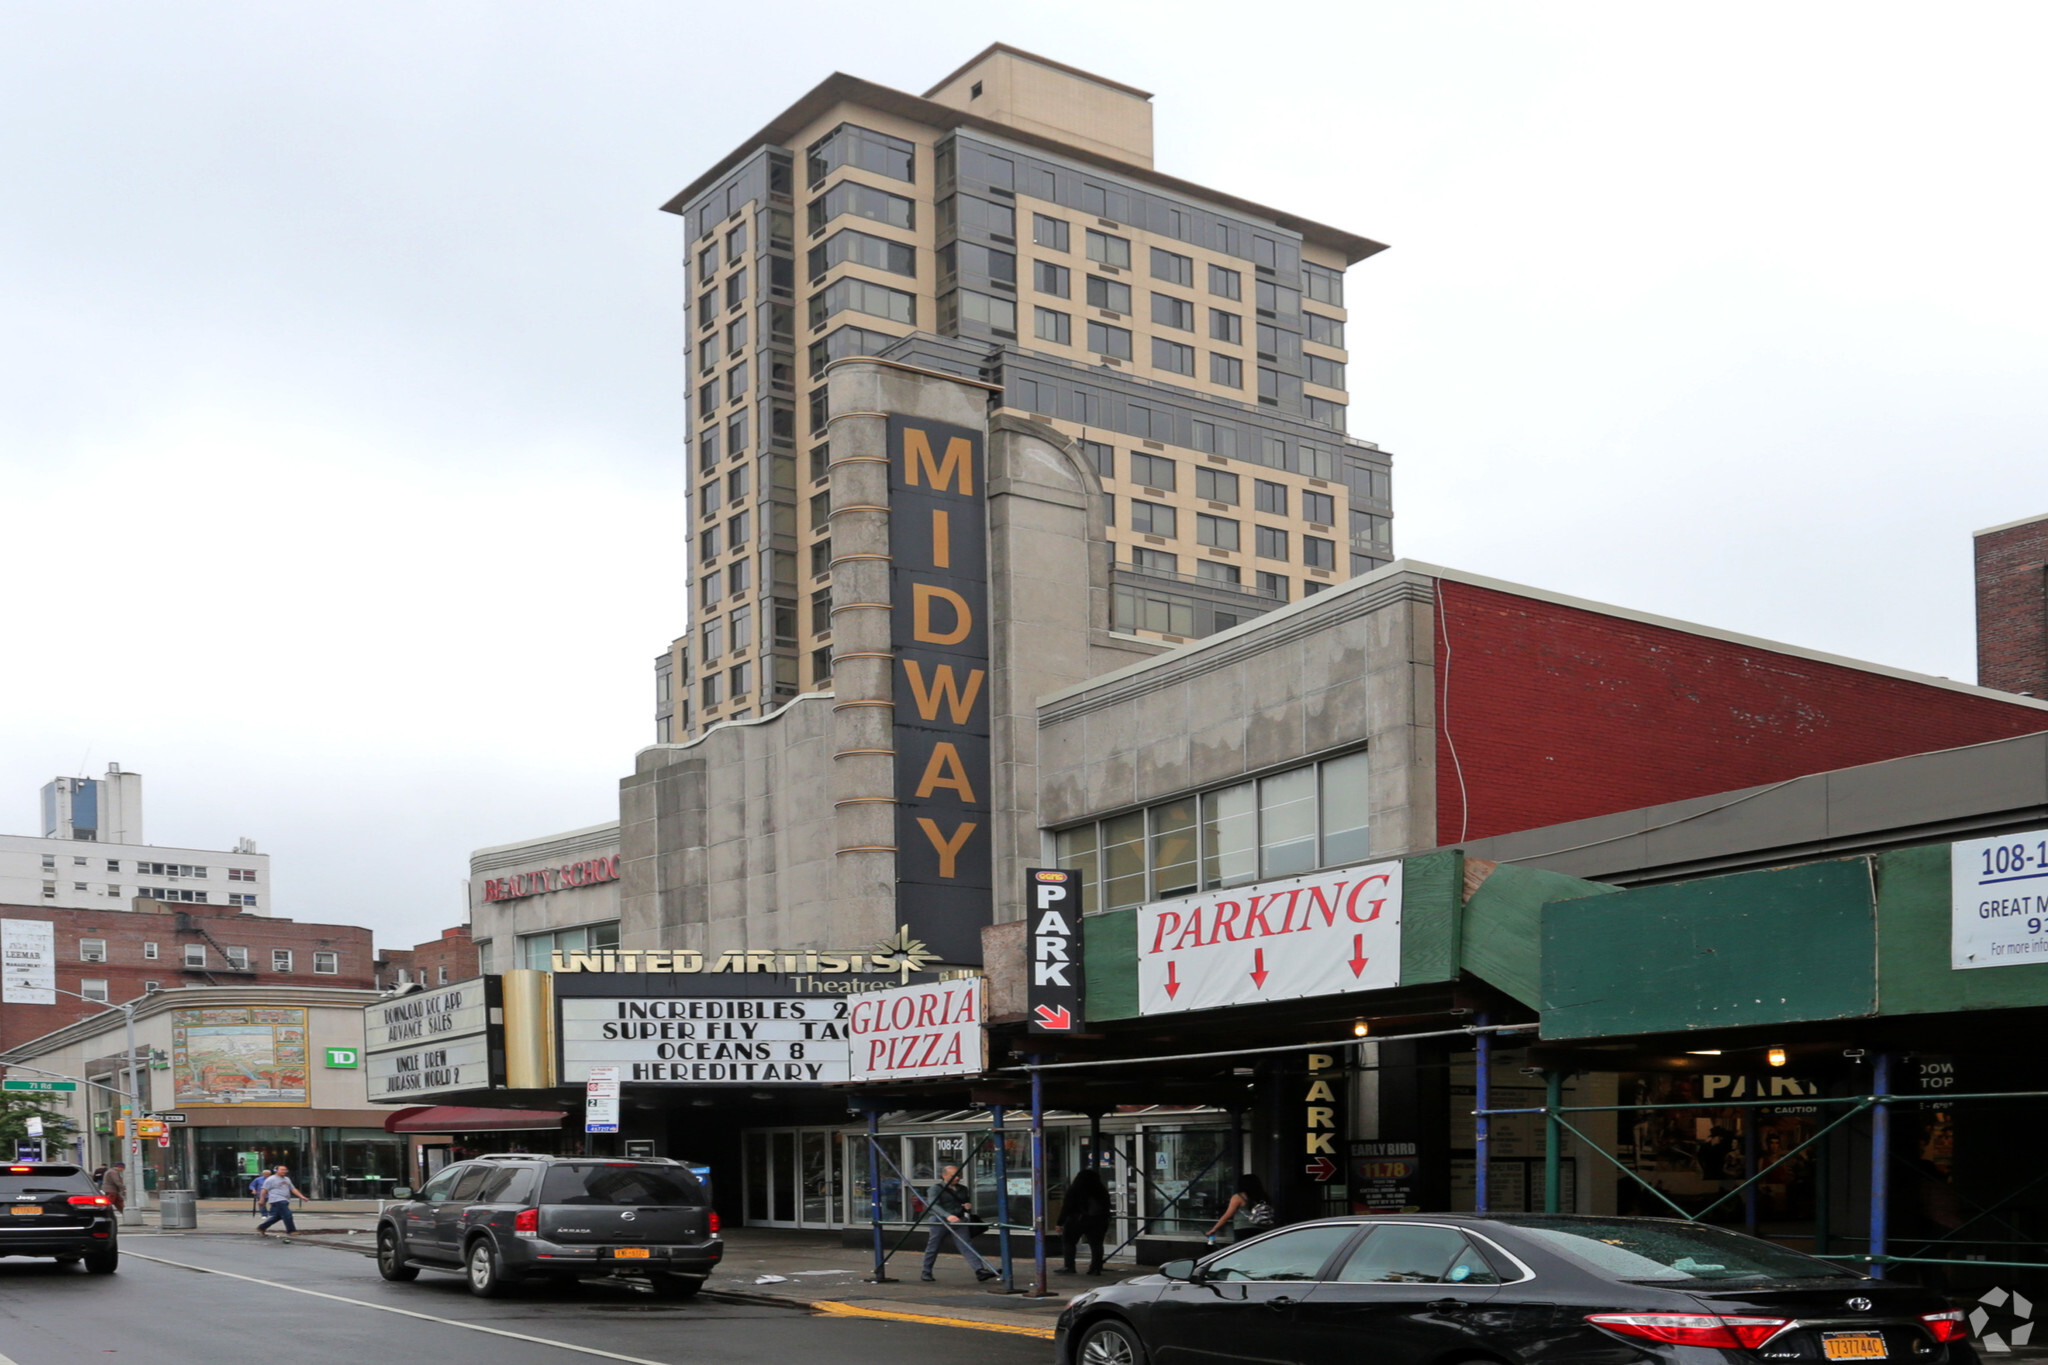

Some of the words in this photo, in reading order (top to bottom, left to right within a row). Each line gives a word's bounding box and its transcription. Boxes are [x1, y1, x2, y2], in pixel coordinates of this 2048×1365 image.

[903, 427, 985, 878] MIDWAY
[484, 869, 552, 902] BEAUTY
[1148, 874, 1390, 954] PARKING
[1979, 896, 2031, 919] GREAT
[1035, 884, 1071, 986] PARK
[5, 950, 41, 959] LEEMAR
[1991, 942, 2005, 956] For
[2007, 943, 2030, 955] more
[551, 949, 703, 973] UNITED
[711, 949, 900, 973] ARTISTS
[789, 975, 896, 994] Theatres
[384, 1001, 423, 1024] DOWNLOAD
[444, 992, 463, 1011] APP
[618, 1001, 806, 1019] INCREDIBLES
[833, 1002, 848, 1019] 2
[851, 987, 976, 1034] GLORIA
[388, 1020, 422, 1041] ADVANCE
[428, 1013, 453, 1034] SALES
[602, 1022, 695, 1040] SUPER
[707, 1022, 758, 1040] FLY
[327, 1050, 356, 1064] TD
[396, 1054, 419, 1073] UNCLE
[424, 1049, 447, 1069] DREW
[657, 1042, 771, 1060] OCEANS
[789, 1042, 804, 1060] 8
[866, 1031, 964, 1071] PIZZA
[386, 1073, 421, 1092] JURASSIC
[424, 1068, 452, 1088] WORLD
[453, 1067, 460, 1084] 2
[632, 1062, 823, 1081] HEREDITARY
[1305, 1054, 1336, 1154] PARK
[937, 1139, 964, 1151] 108-22
[1351, 1143, 1385, 1157] EARLY
[1387, 1142, 1416, 1156] BIRD
[1158, 1154, 1167, 1165] A
[1363, 1162, 1406, 1178] 11.78
[1828, 1339, 1880, 1355] T737744C
